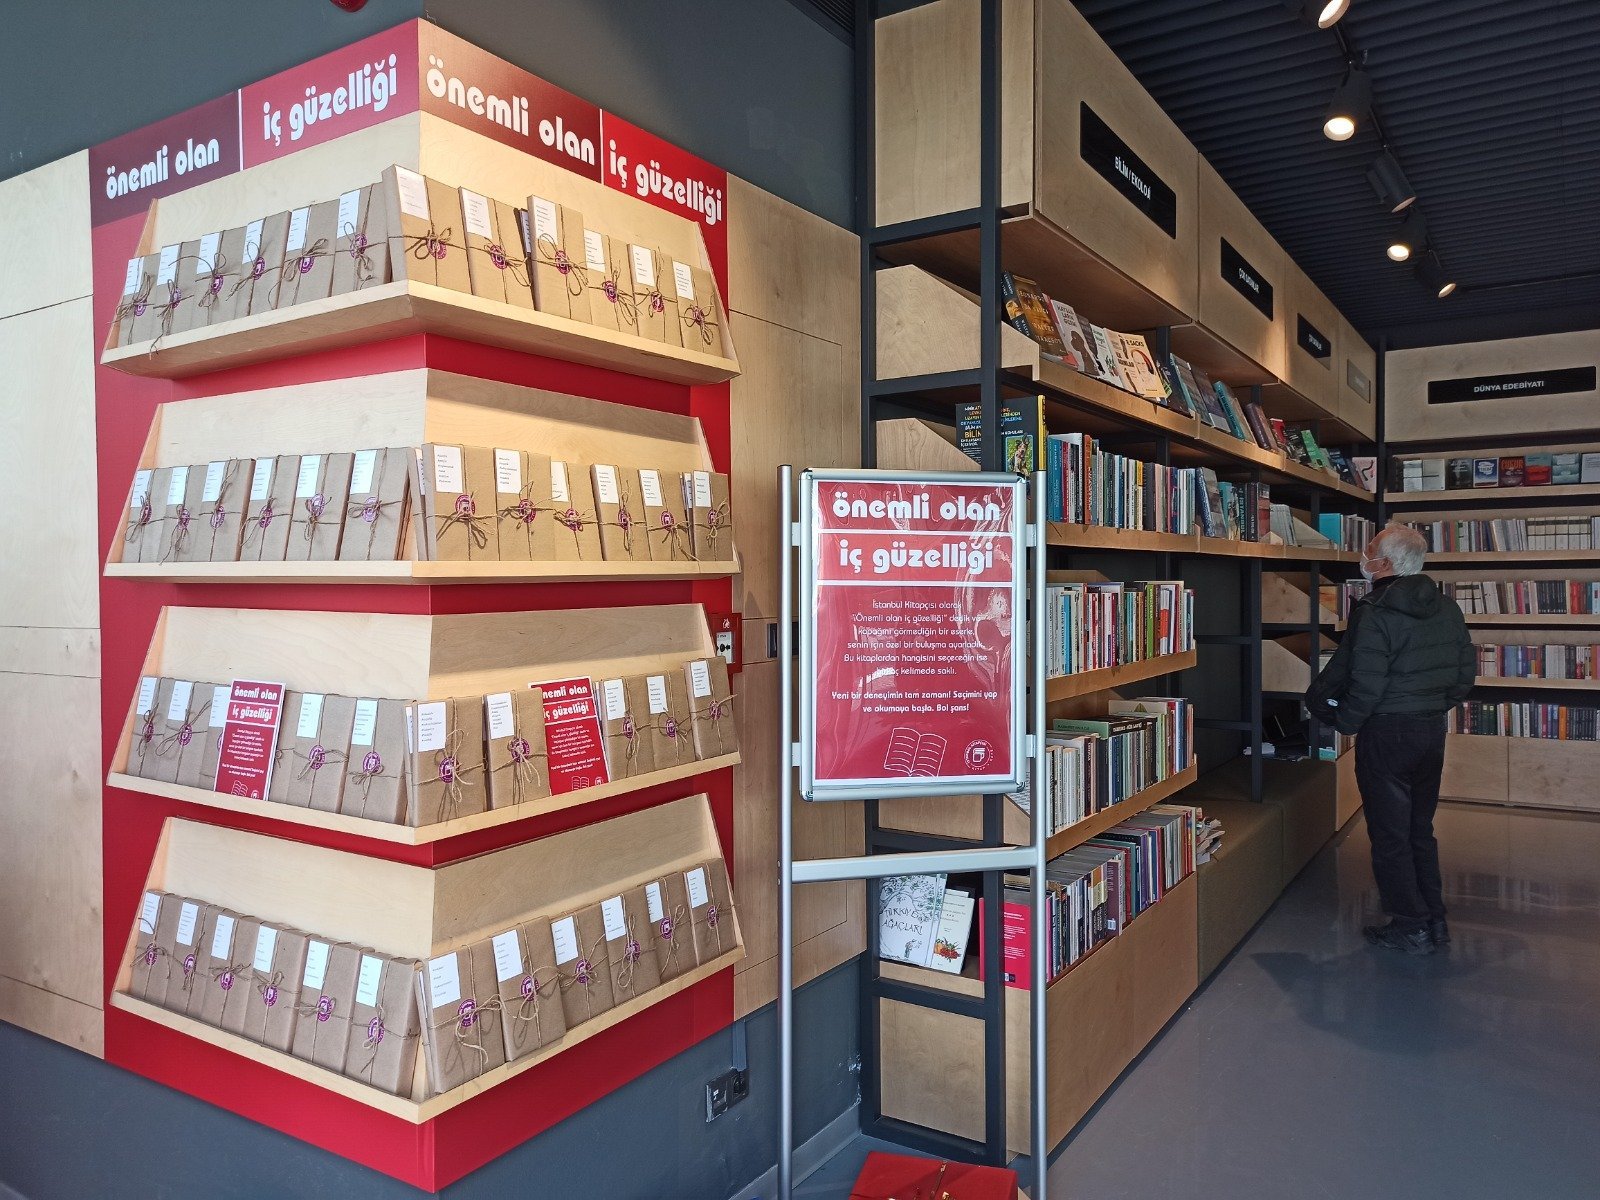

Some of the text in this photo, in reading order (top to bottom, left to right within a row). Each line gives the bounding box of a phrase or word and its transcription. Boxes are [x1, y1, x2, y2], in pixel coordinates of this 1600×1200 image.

[263, 53, 398, 147] iç güzelliği
[426, 54, 596, 165] önemli olan
[106, 137, 220, 200] önemli olan
[609, 139, 724, 226] iç güzelliği
[1474, 380, 1545, 393] DÜNYA EDEBİYATI
[833, 491, 1001, 521] önemli olan
[839, 538, 994, 575] iç güzelliği
[873, 599, 962, 611] İstanbul Kitapçısı olarak
[885, 614, 902, 622] olan
[904, 614, 911, 623] iç
[858, 627, 893, 637] kapağını
[894, 627, 937, 637] görmediğin
[939, 628, 949, 636] bir
[847, 641, 869, 649] senin
[870, 641, 884, 650] için
[885, 641, 902, 649] özel
[903, 641, 914, 649] bir
[915, 641, 947, 650] buluşma
[844, 653, 988, 663] Bu kitaplardan hangisini seçeceğin ise
[900, 667, 936, 675] kelimede
[937, 667, 957, 675] saklı.
[234, 685, 278, 701] önemli olan
[542, 685, 588, 700] nemli olan
[831, 691, 849, 699] Yeni
[851, 691, 862, 699] bir
[863, 691, 903, 701] deneyimin
[921, 691, 951, 699] zamanı!
[953, 690, 982, 701] Seçimini
[983, 692, 998, 700] yap
[232, 704, 273, 722] iç güzelliği
[552, 700, 590, 719] güzelliği
[874, 705, 910, 713] okumaya
[911, 704, 935, 714] başla.
[936, 704, 949, 712] Bol
[950, 703, 970, 714] şans!
